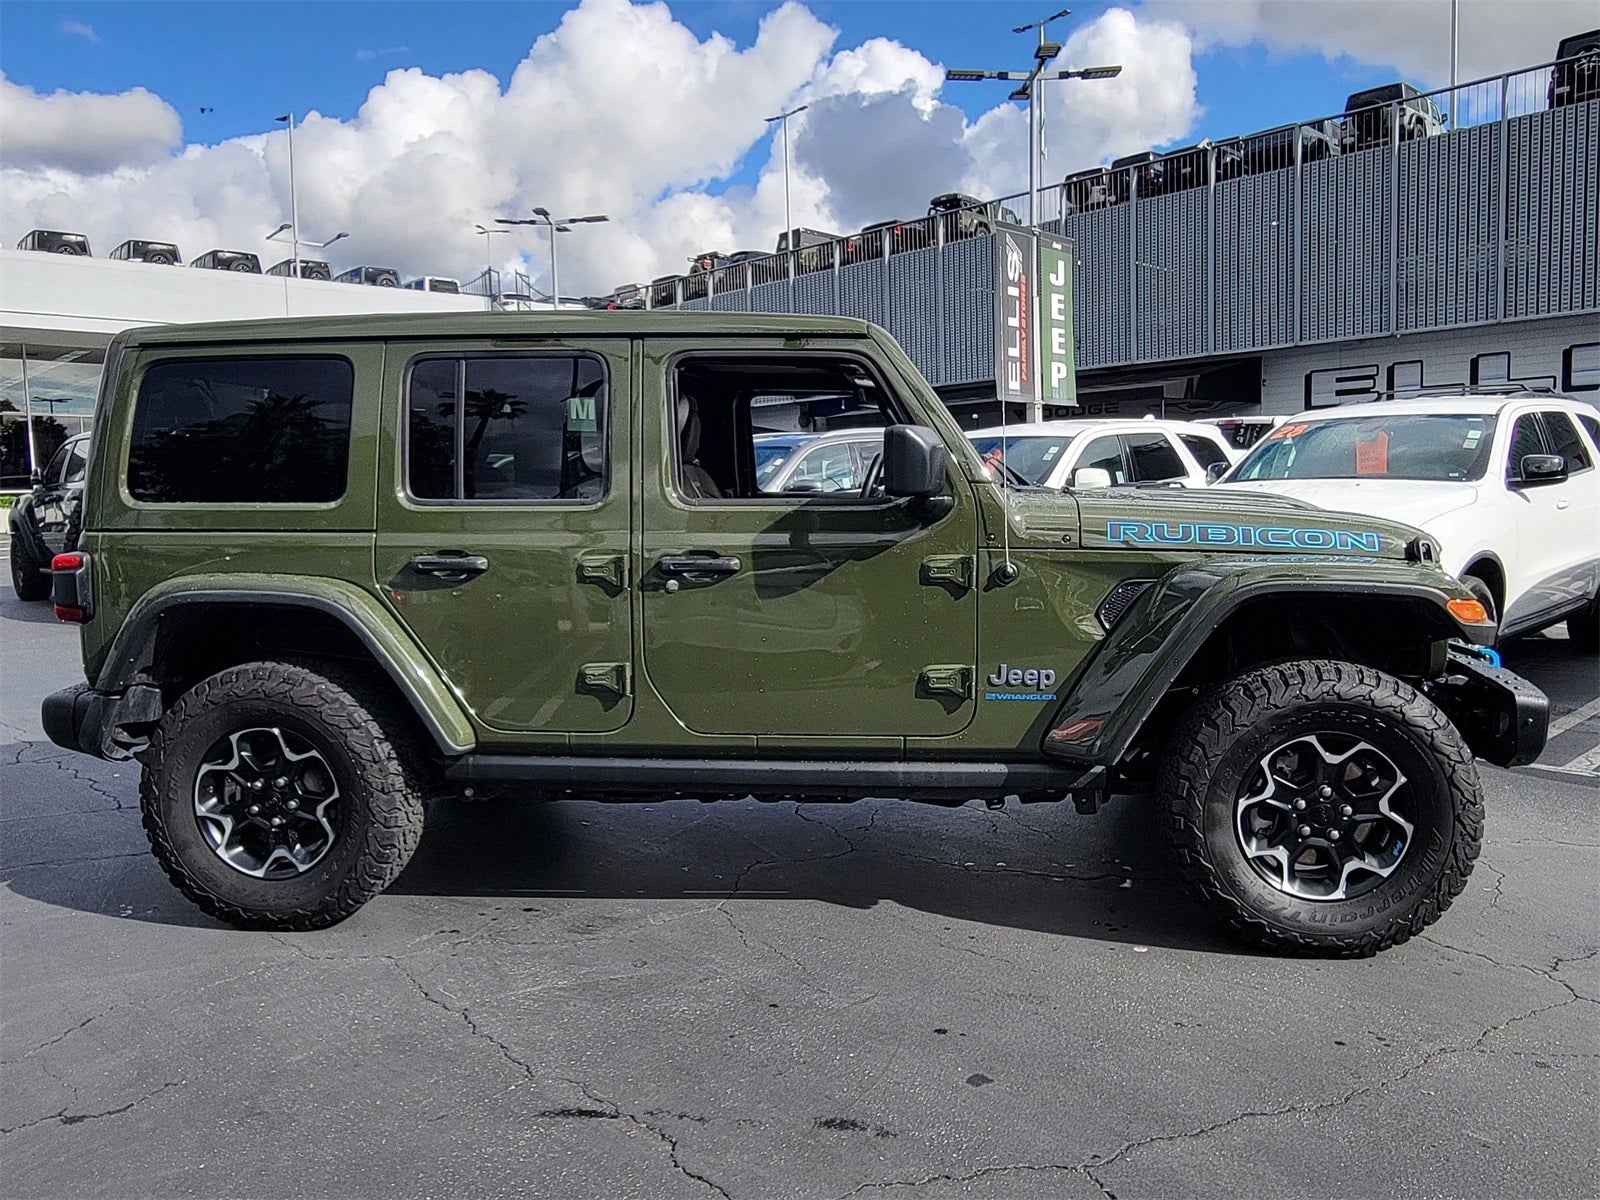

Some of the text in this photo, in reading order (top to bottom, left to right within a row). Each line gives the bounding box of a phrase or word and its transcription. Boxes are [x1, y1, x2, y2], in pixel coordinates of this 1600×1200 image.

[1007, 250, 1021, 391] ELLIS
[1049, 260, 1067, 388] JEEP
[571, 399, 595, 419] M
[1107, 521, 1379, 552] RUBICON
[989, 664, 1056, 689] Jeep
